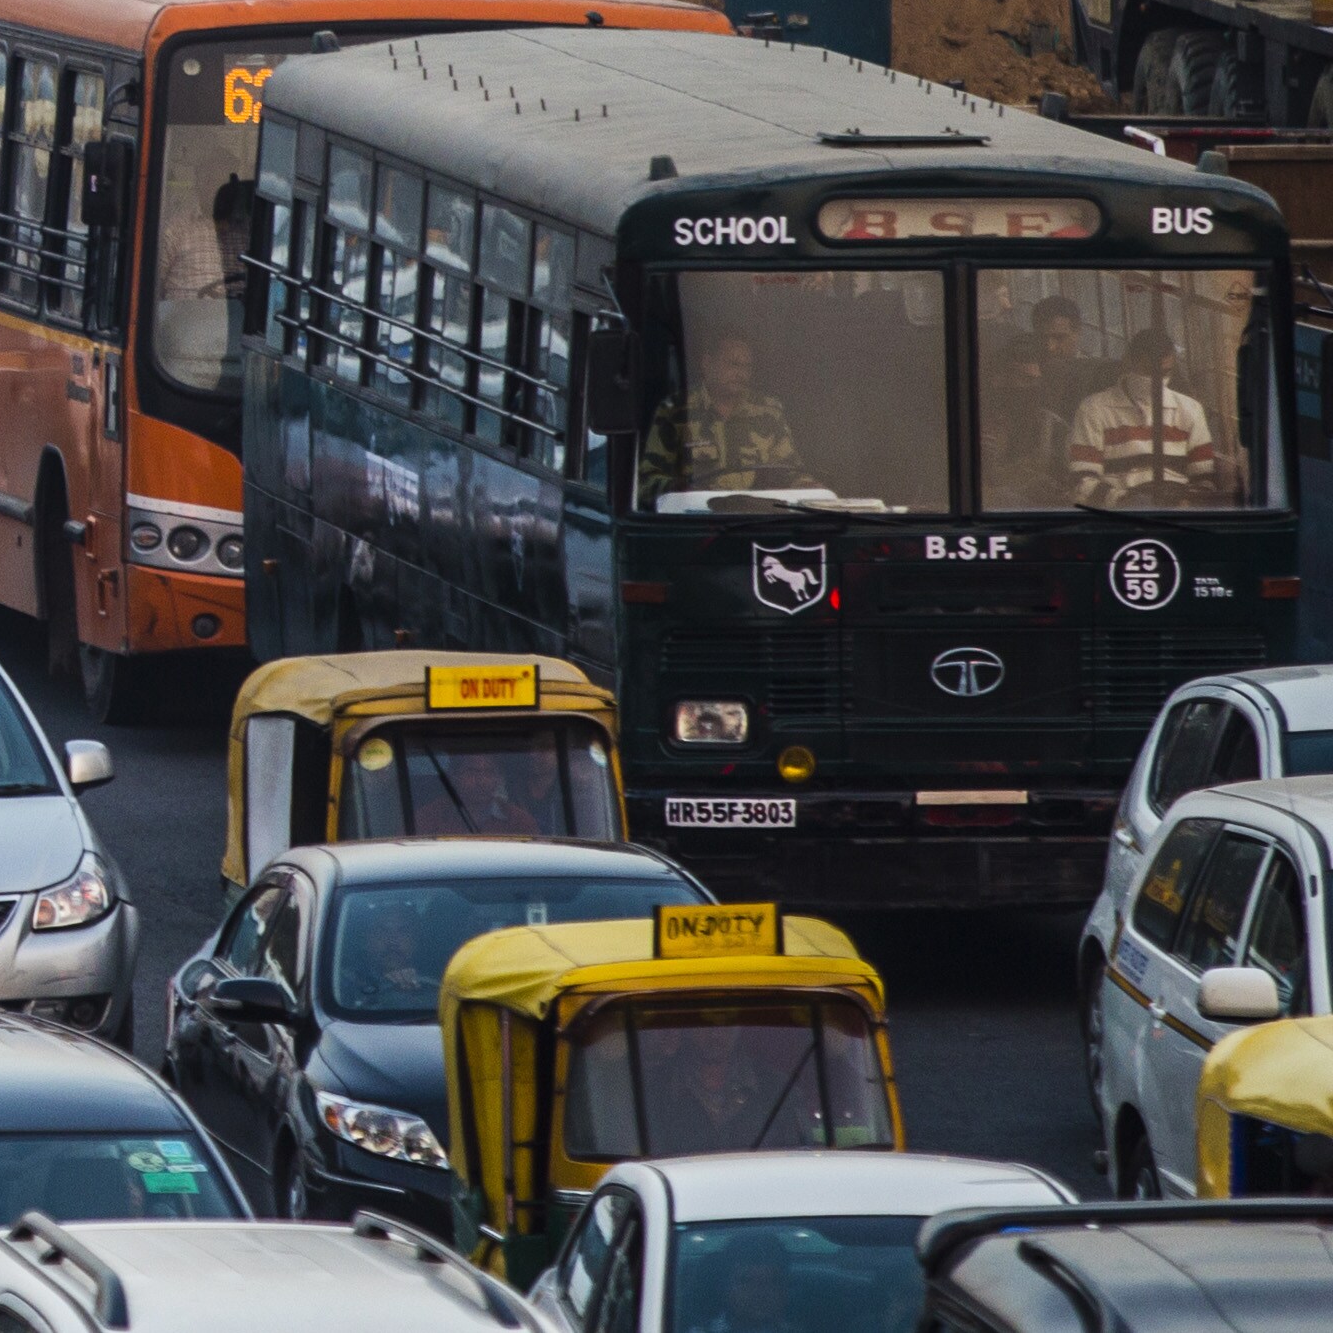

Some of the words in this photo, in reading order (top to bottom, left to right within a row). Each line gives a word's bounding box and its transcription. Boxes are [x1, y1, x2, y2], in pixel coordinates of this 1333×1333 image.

[675, 216, 797, 246] SCHOOL
[1151, 206, 1214, 235] BUS
[925, 535, 1014, 560] B.S.F.
[1124, 549, 1158, 571] 25
[1126, 579, 1159, 601] 59
[1194, 577, 1220, 585] TATA
[461, 679, 479, 699] ON
[483, 678, 516, 699] DUTY
